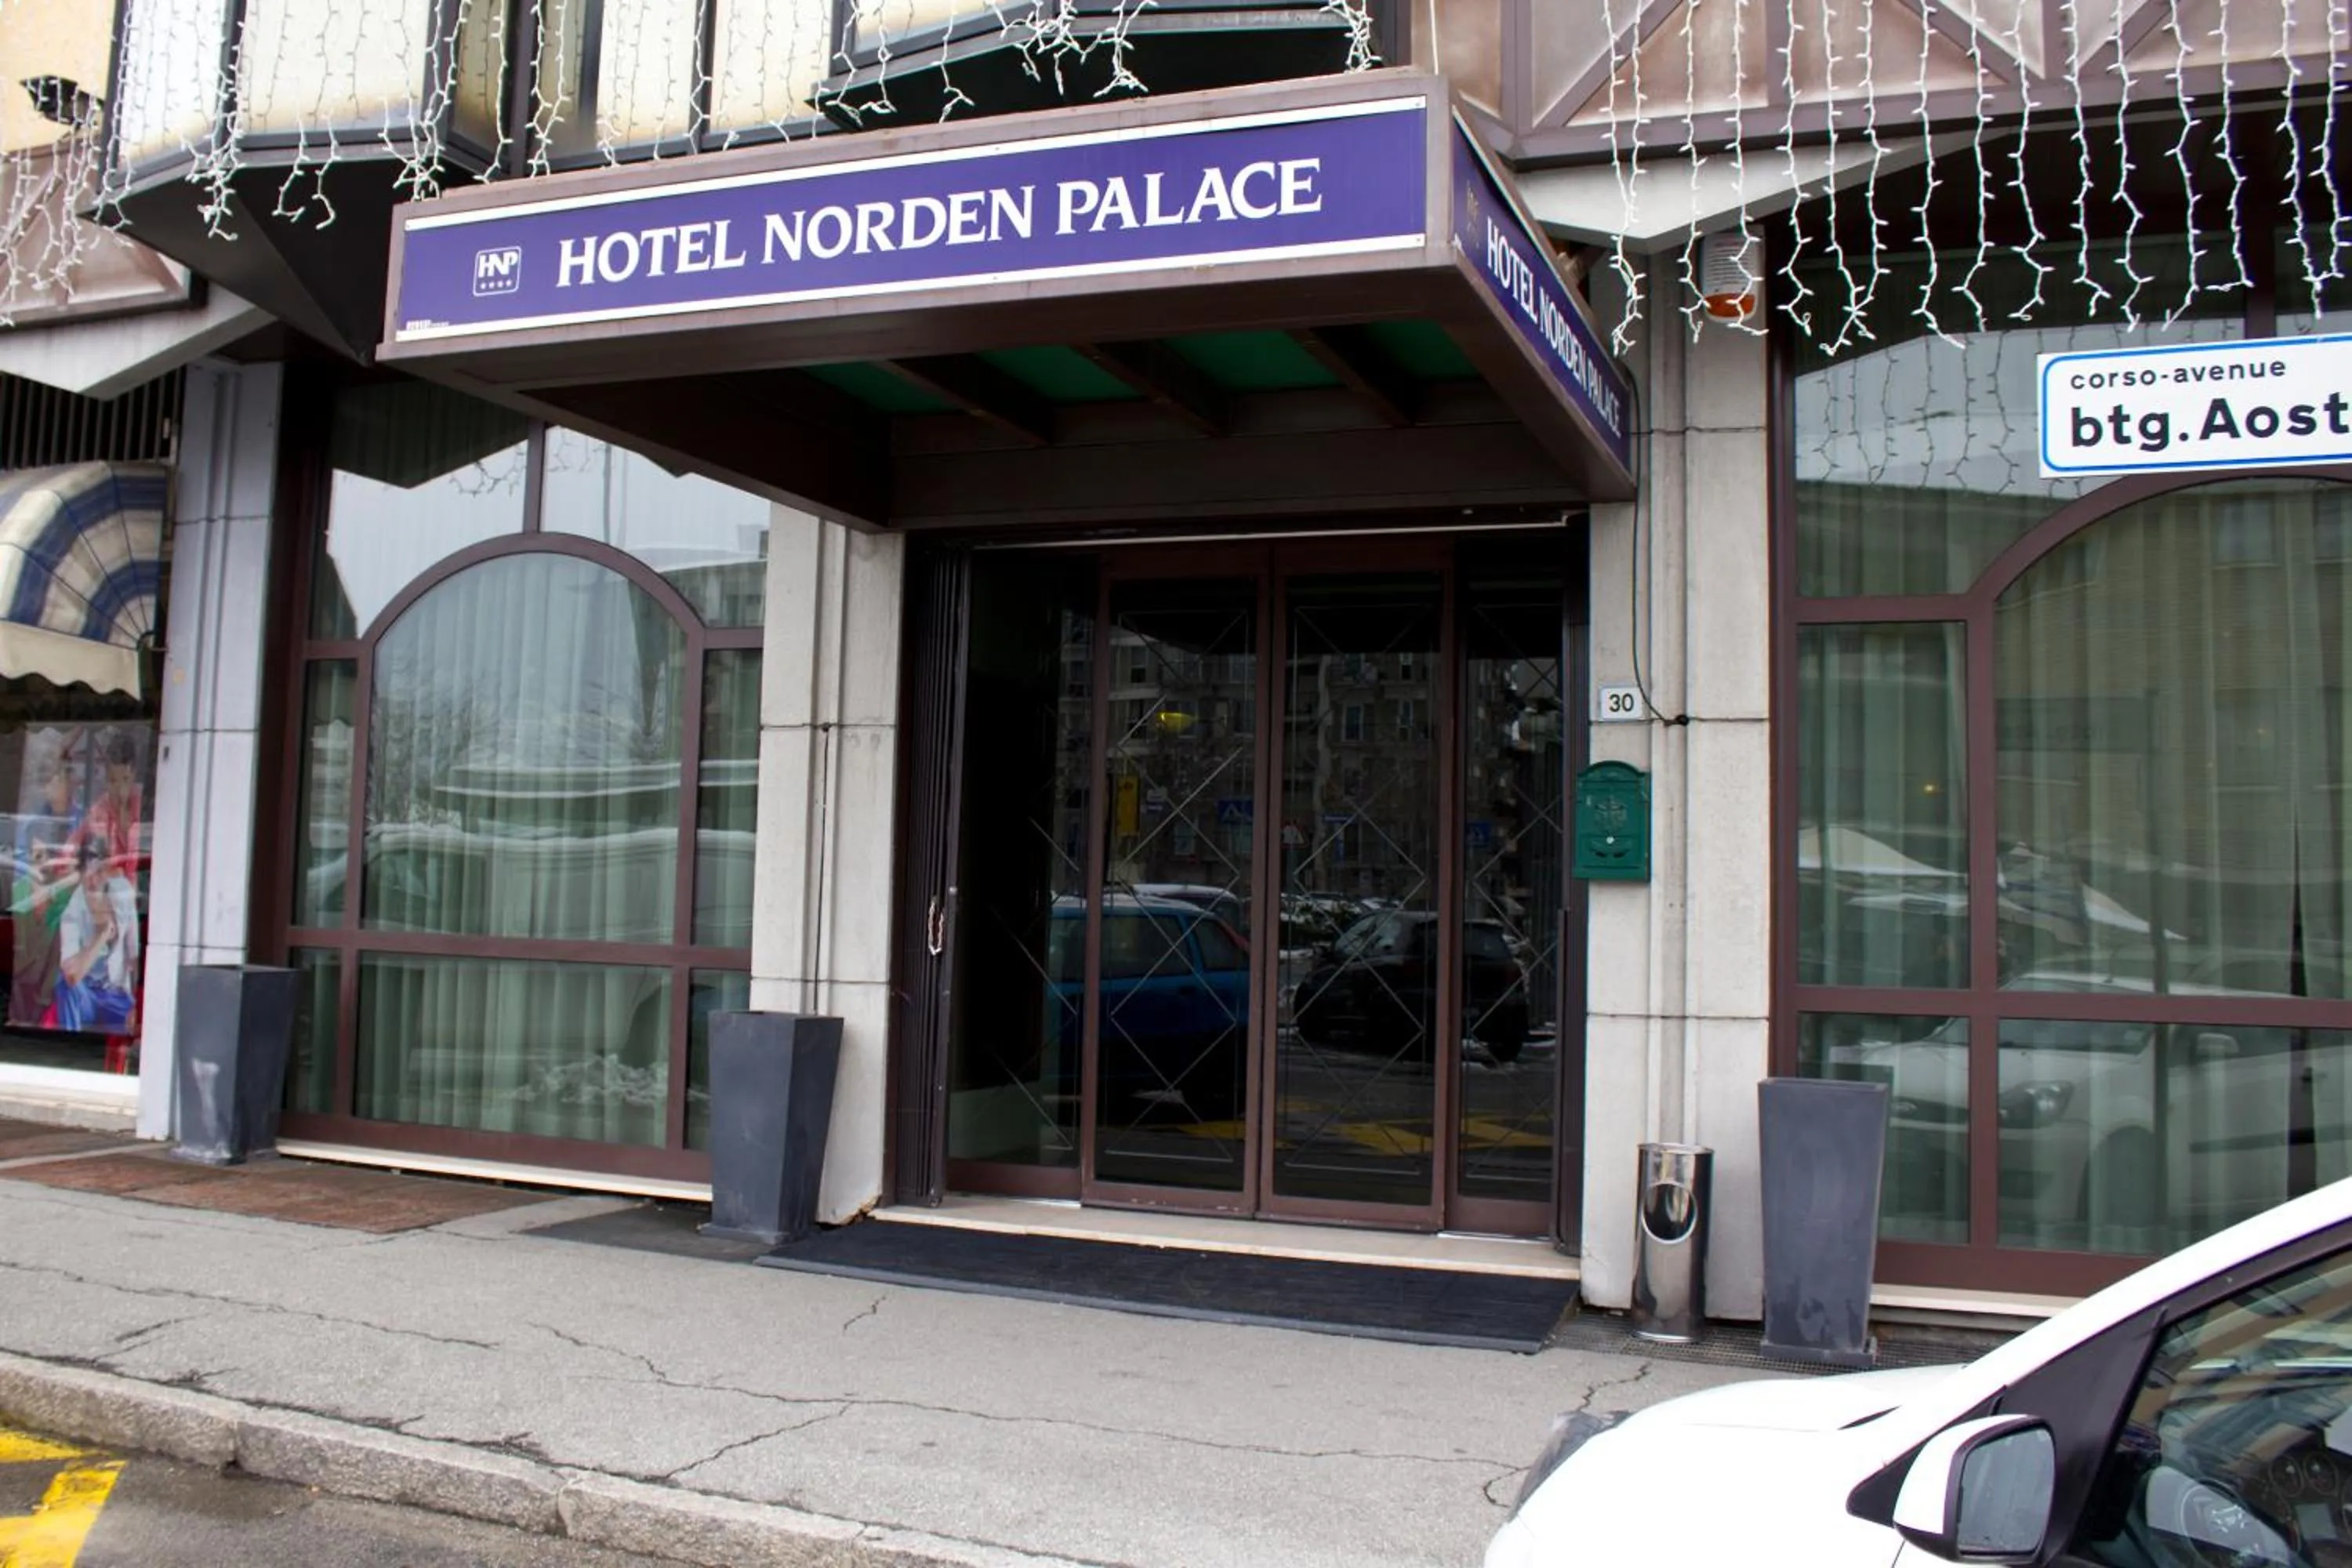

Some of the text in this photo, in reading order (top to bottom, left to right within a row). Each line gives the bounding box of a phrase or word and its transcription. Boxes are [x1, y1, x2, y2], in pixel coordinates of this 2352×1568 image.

[556, 158, 1323, 288] HOTEL NORDEN PALACE
[478, 252, 518, 278] HNP
[1486, 215, 1621, 439] HOTEL NORDEN PALACE
[2070, 360, 2287, 390] corso-avenue
[2070, 391, 2350, 453] btg.Aost
[1609, 693, 1635, 713] 30
